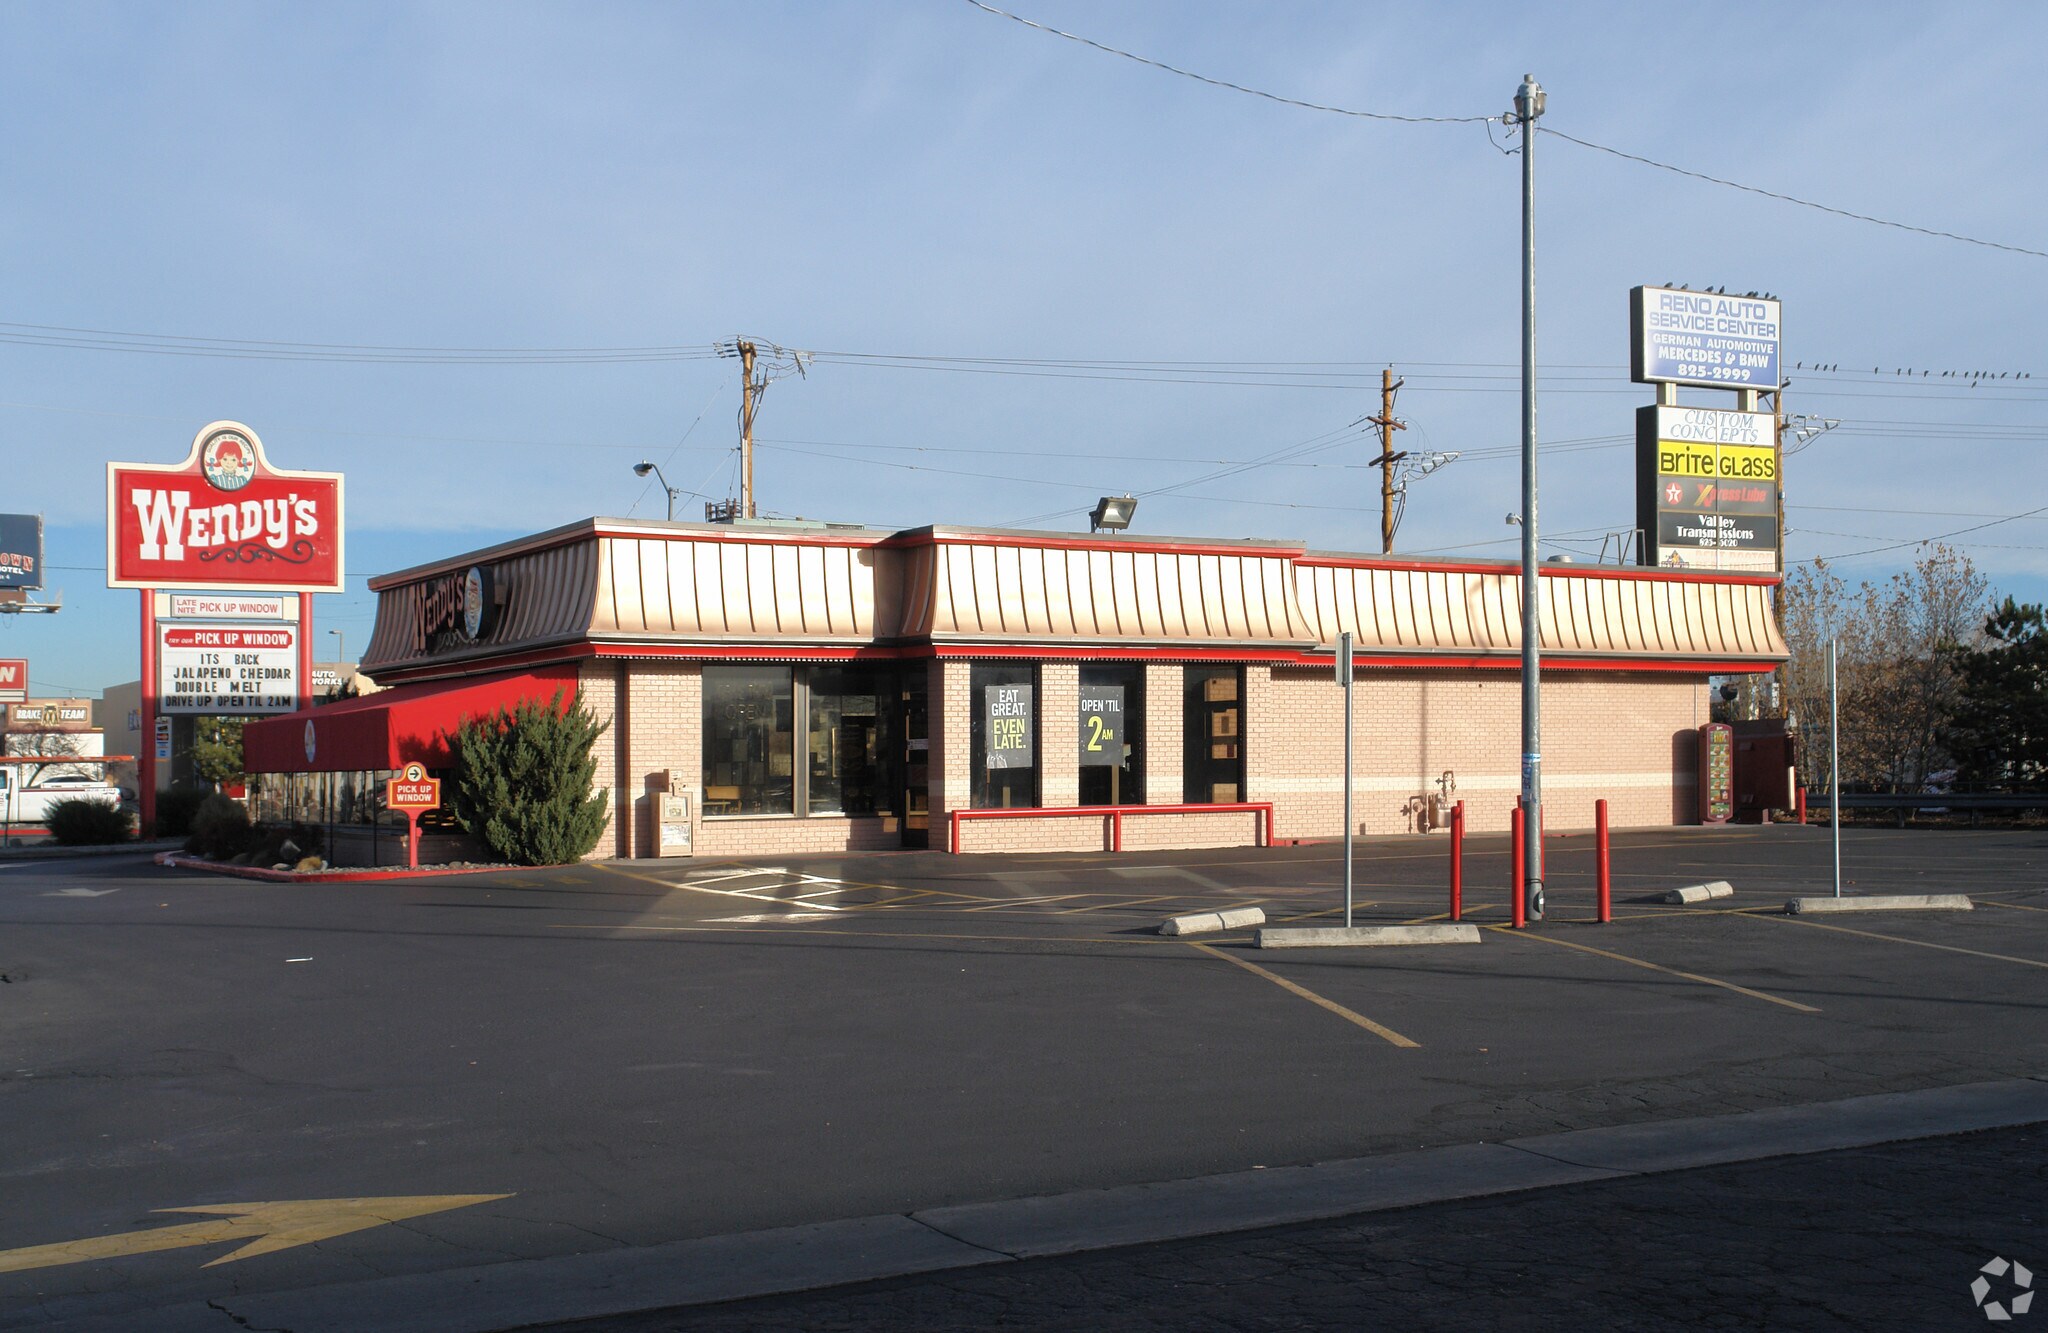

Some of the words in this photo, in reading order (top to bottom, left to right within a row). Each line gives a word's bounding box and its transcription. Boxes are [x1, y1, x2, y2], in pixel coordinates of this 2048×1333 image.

[1660, 294, 1712, 315] RENO
[1716, 301, 1766, 320] AUTO
[1649, 312, 1714, 331] SERVICE
[1717, 319, 1776, 338] CENTER
[1653, 333, 1701, 347] GERMAN
[1706, 338, 1774, 354] AUTOMOTIVE
[1658, 346, 1721, 364] MERCEDES
[1725, 352, 1736, 365] &
[1739, 354, 1769, 368] BMW
[1678, 363, 1751, 381] 825-2999
[1684, 409, 1755, 428] CUSTOM
[1670, 424, 1758, 443] CONCEPTS
[1698, 514, 1736, 528] Valley
[1676, 526, 1754, 540] Transmissions
[0, 566, 24, 575] OTEL
[199, 603, 221, 612] PICK
[224, 603, 237, 612] UP
[239, 603, 278, 613] WINDOW
[195, 633, 220, 644] PICK
[224, 633, 239, 644] UP
[242, 633, 288, 645] WINDOW
[200, 653, 220, 665] ITS
[234, 654, 260, 665] BACK
[173, 667, 231, 679] JALAPENO
[240, 668, 291, 679] CHEDDAR
[312, 670, 335, 678] AUTO
[175, 681, 217, 693] DOUBLE
[229, 681, 262, 693] MELT
[165, 695, 193, 707] DRIVE
[197, 695, 212, 707] UP
[217, 695, 244, 707] OPEN
[248, 695, 263, 707] TIL
[267, 695, 291, 707] 2AM
[999, 689, 1018, 703] EAT
[991, 703, 1026, 716] GREAT.
[1081, 699, 1103, 712] OPEN
[1105, 699, 1120, 712] 'TIL
[16, 709, 42, 719] BRAKE
[60, 709, 85, 719] TEAM
[993, 718, 1025, 734] EVEN
[993, 734, 1026, 750] LATE.
[397, 785, 417, 793] PICK
[420, 785, 432, 793] UP
[396, 794, 432, 802] WINDOW
